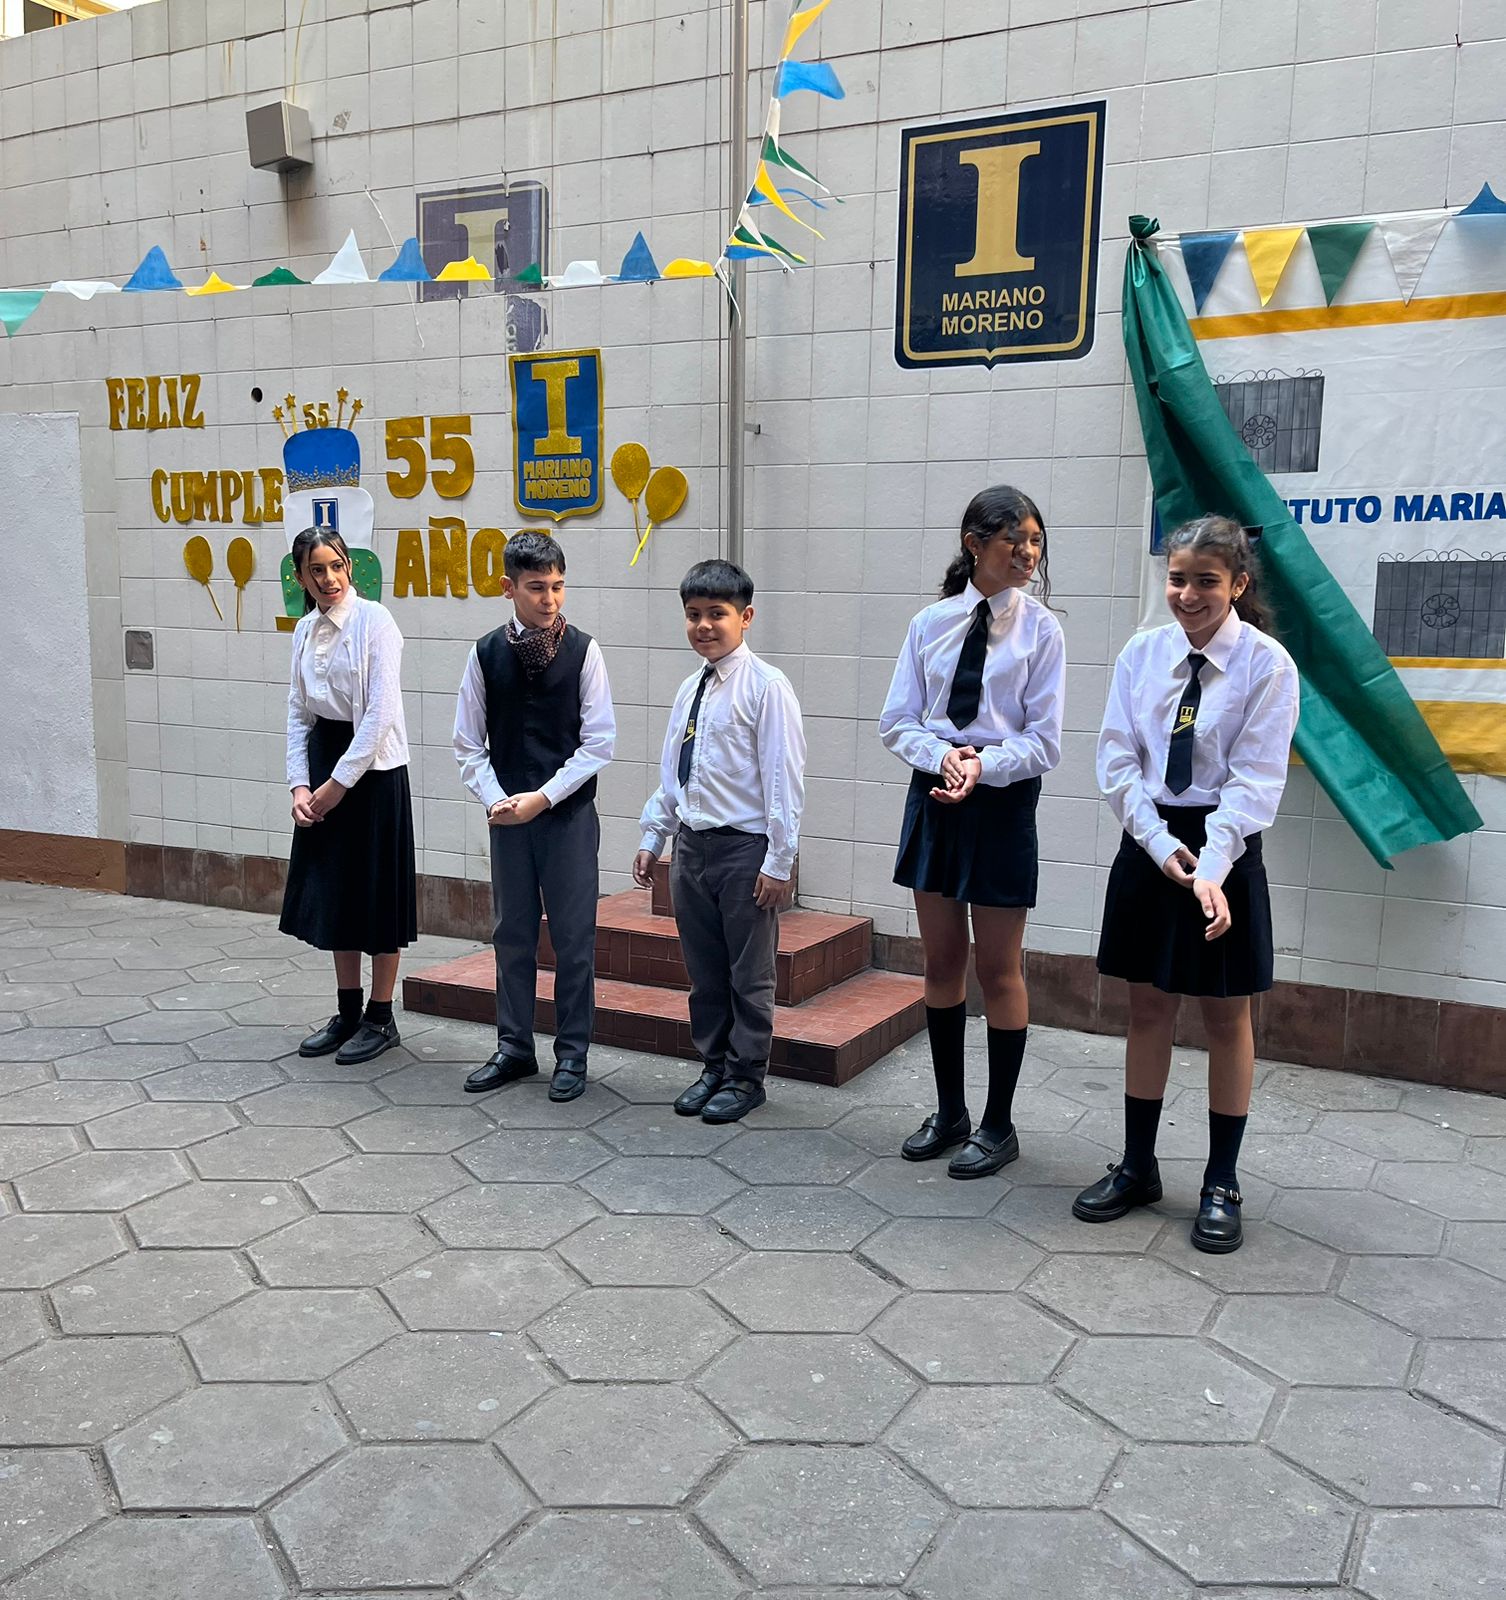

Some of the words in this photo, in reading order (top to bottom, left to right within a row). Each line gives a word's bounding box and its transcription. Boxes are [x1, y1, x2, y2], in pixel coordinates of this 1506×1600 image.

[955, 141, 1041, 277] I
[942, 286, 1046, 312] MARIANO
[942, 309, 1044, 336] MORENO
[106, 374, 205, 430] FELIZ
[302, 401, 330, 430] 55
[532, 359, 582, 455] I
[385, 415, 475, 500] 55
[523, 458, 592, 479] MARIANO
[151, 468, 285, 523] CUMPLE
[525, 479, 591, 499] MORENO
[1283, 495, 1382, 524] TUTO
[393, 516, 552, 598] AÑO
